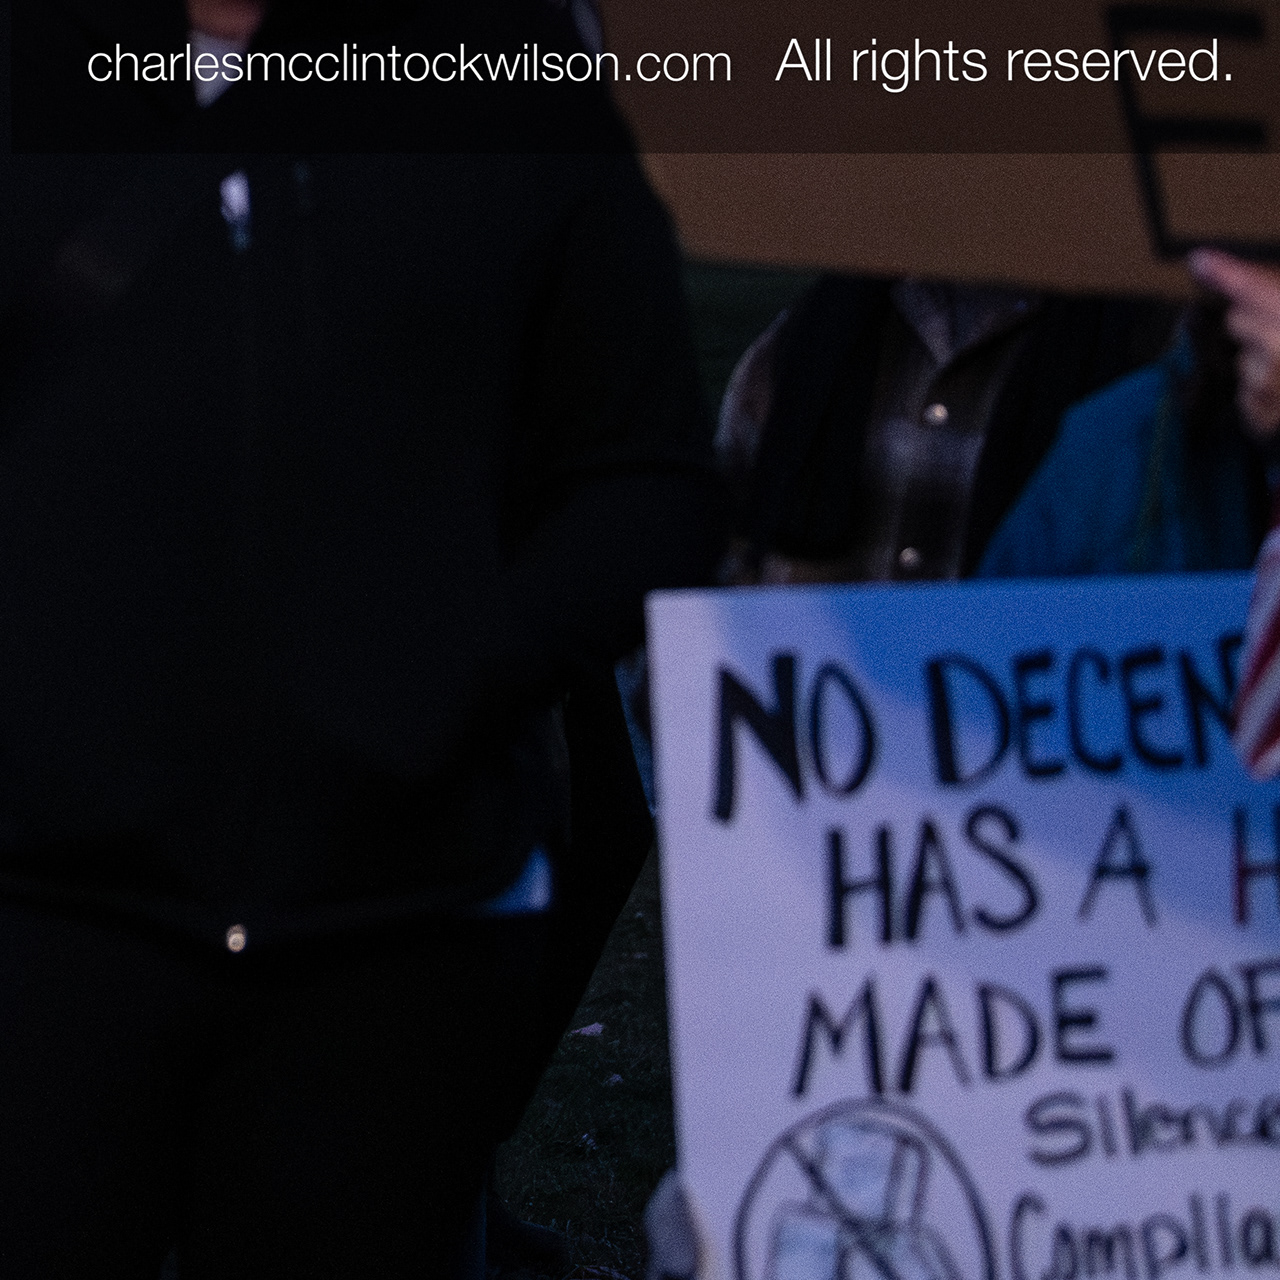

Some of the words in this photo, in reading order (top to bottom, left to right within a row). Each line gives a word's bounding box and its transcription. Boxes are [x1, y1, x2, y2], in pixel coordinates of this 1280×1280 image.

[712, 648, 875, 825] NO
[926, 632, 1242, 786] DECEN
[824, 805, 1036, 950] HAS
[1078, 802, 1154, 926] A
[1230, 802, 1280, 926] H
[790, 962, 1116, 1102] MADE
